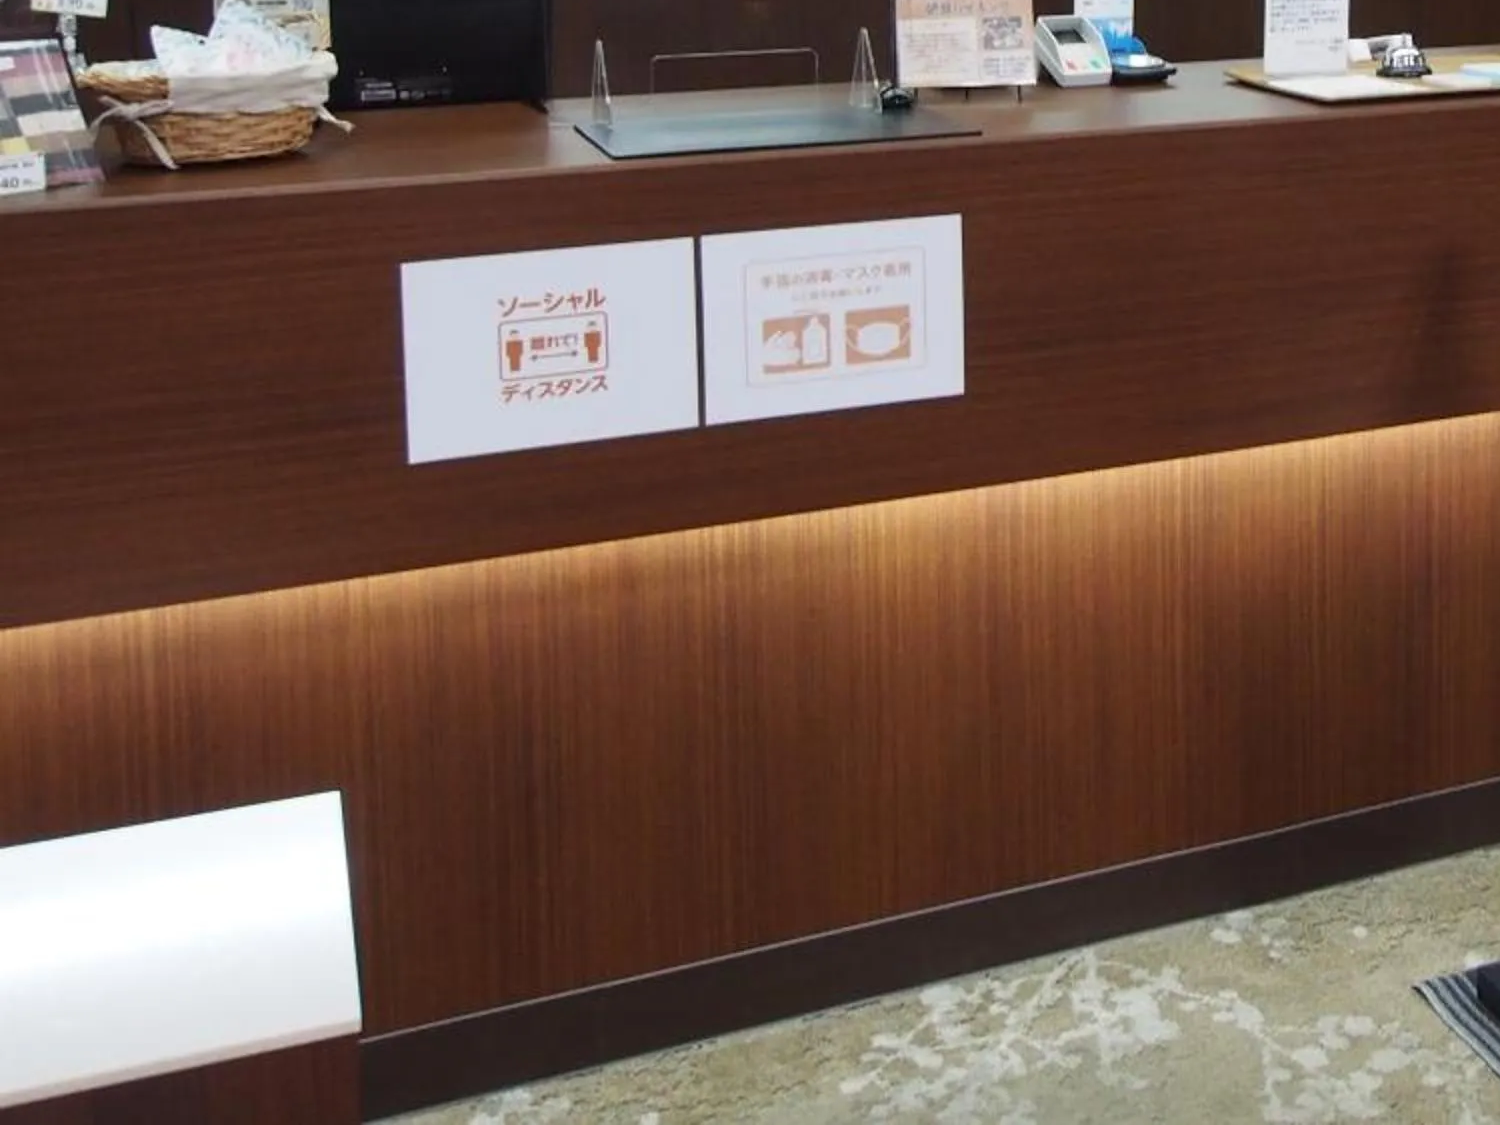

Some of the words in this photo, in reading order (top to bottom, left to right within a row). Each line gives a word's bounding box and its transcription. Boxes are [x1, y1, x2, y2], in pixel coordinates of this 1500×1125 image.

[497, 288, 606, 317] ソーシャル
[501, 374, 609, 403] ディスタンス
